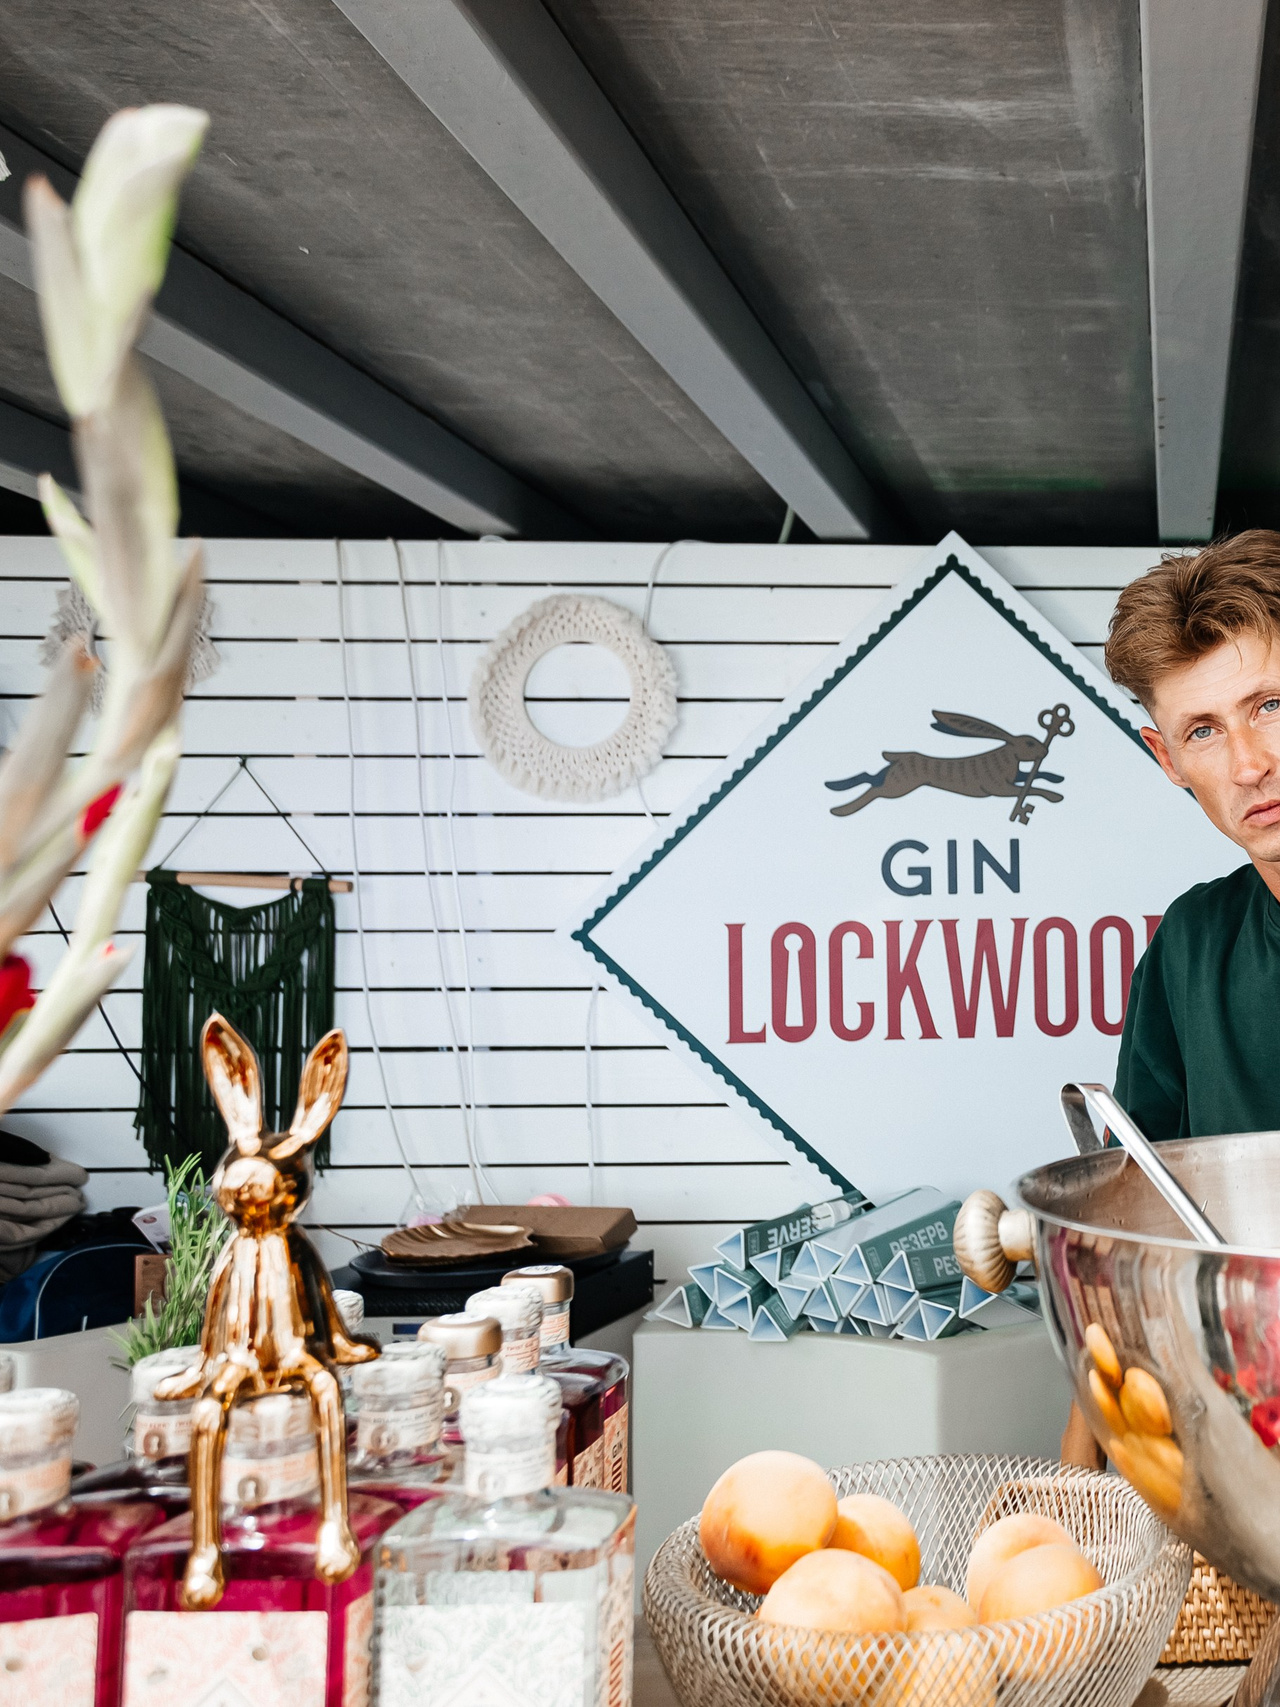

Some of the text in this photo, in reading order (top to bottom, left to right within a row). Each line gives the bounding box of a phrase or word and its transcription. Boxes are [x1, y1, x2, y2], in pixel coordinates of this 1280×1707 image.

[881, 838, 1020, 897] GIN
[724, 915, 1163, 1045] LOCKWOO
[767, 1215, 819, 1250] ERVE
[933, 1254, 962, 1277] РЕЗ
